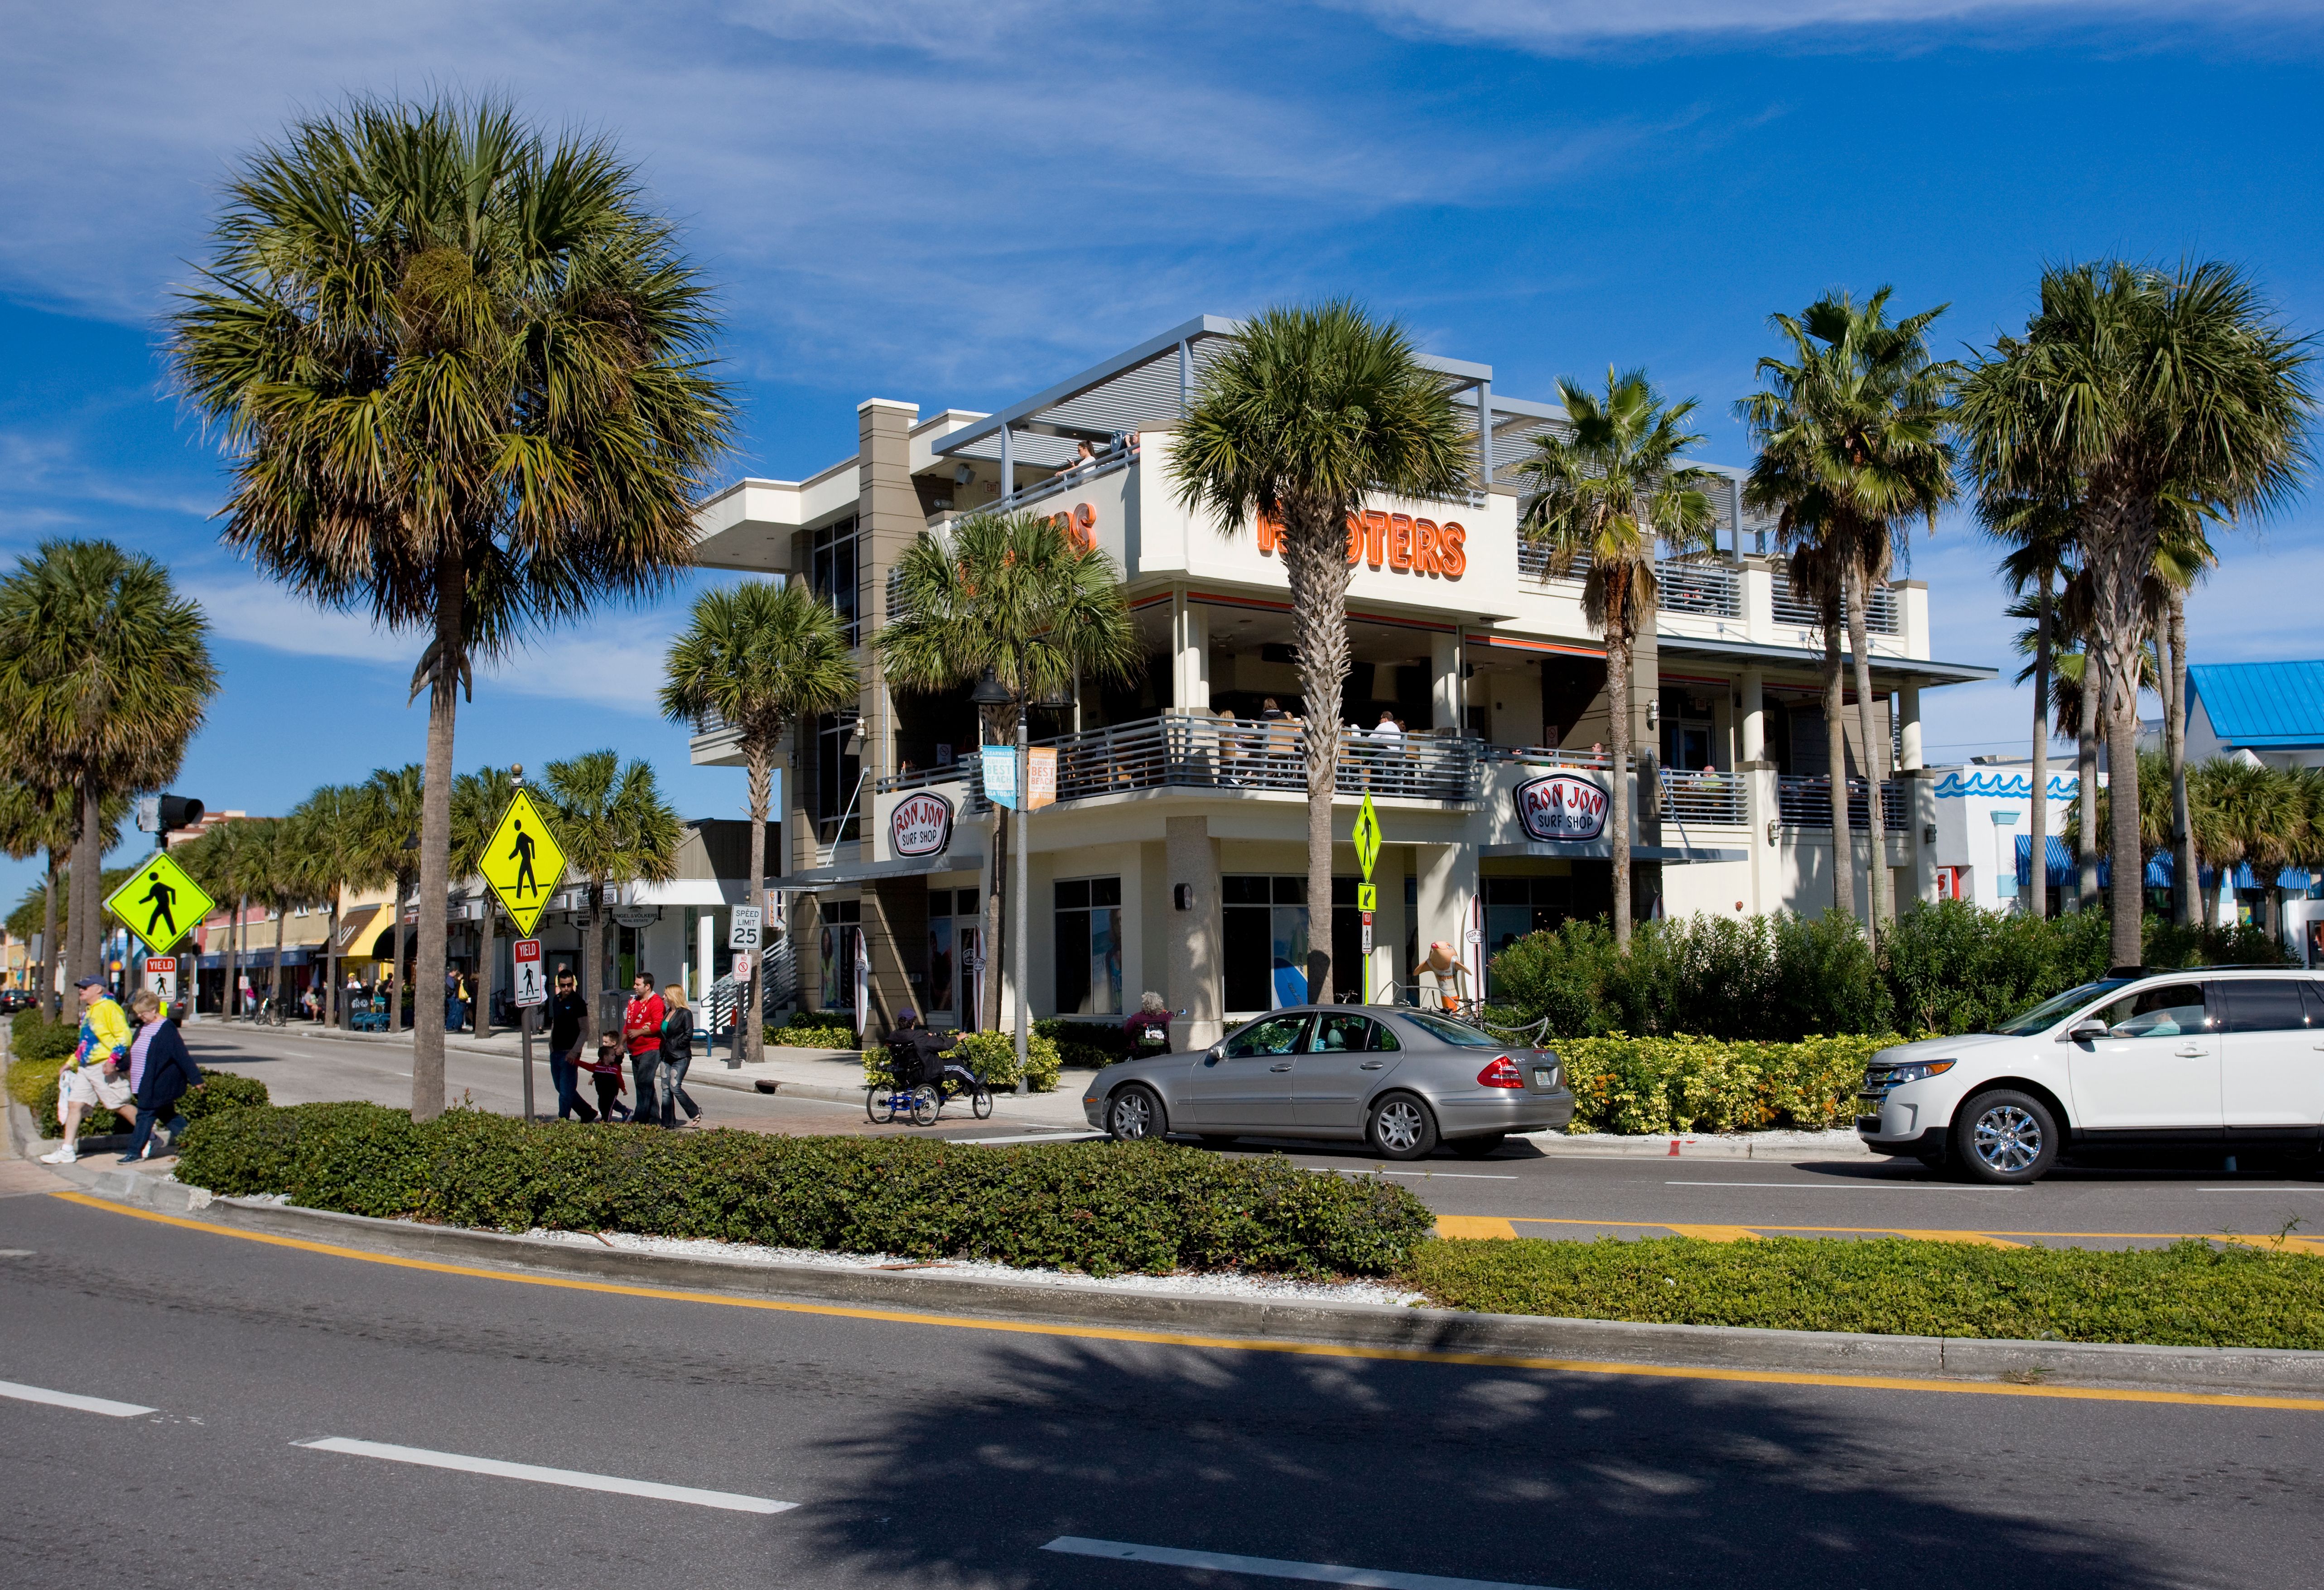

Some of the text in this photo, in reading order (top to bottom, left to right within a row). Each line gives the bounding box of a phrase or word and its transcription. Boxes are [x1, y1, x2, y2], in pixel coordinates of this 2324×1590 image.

[987, 483, 996, 492] EXIT
[1257, 499, 1466, 576] HOTERS
[986, 765, 1012, 775] BEST
[1032, 767, 1054, 776] BEST
[1528, 784, 1603, 816] RON JON
[896, 802, 943, 837] RON JON
[1538, 814, 1593, 829] SURF SHOP
[902, 829, 937, 846] SURF SHOP
[734, 928, 757, 944] 25
[519, 944, 536, 957] YIELD
[149, 961, 173, 970] YIELD
